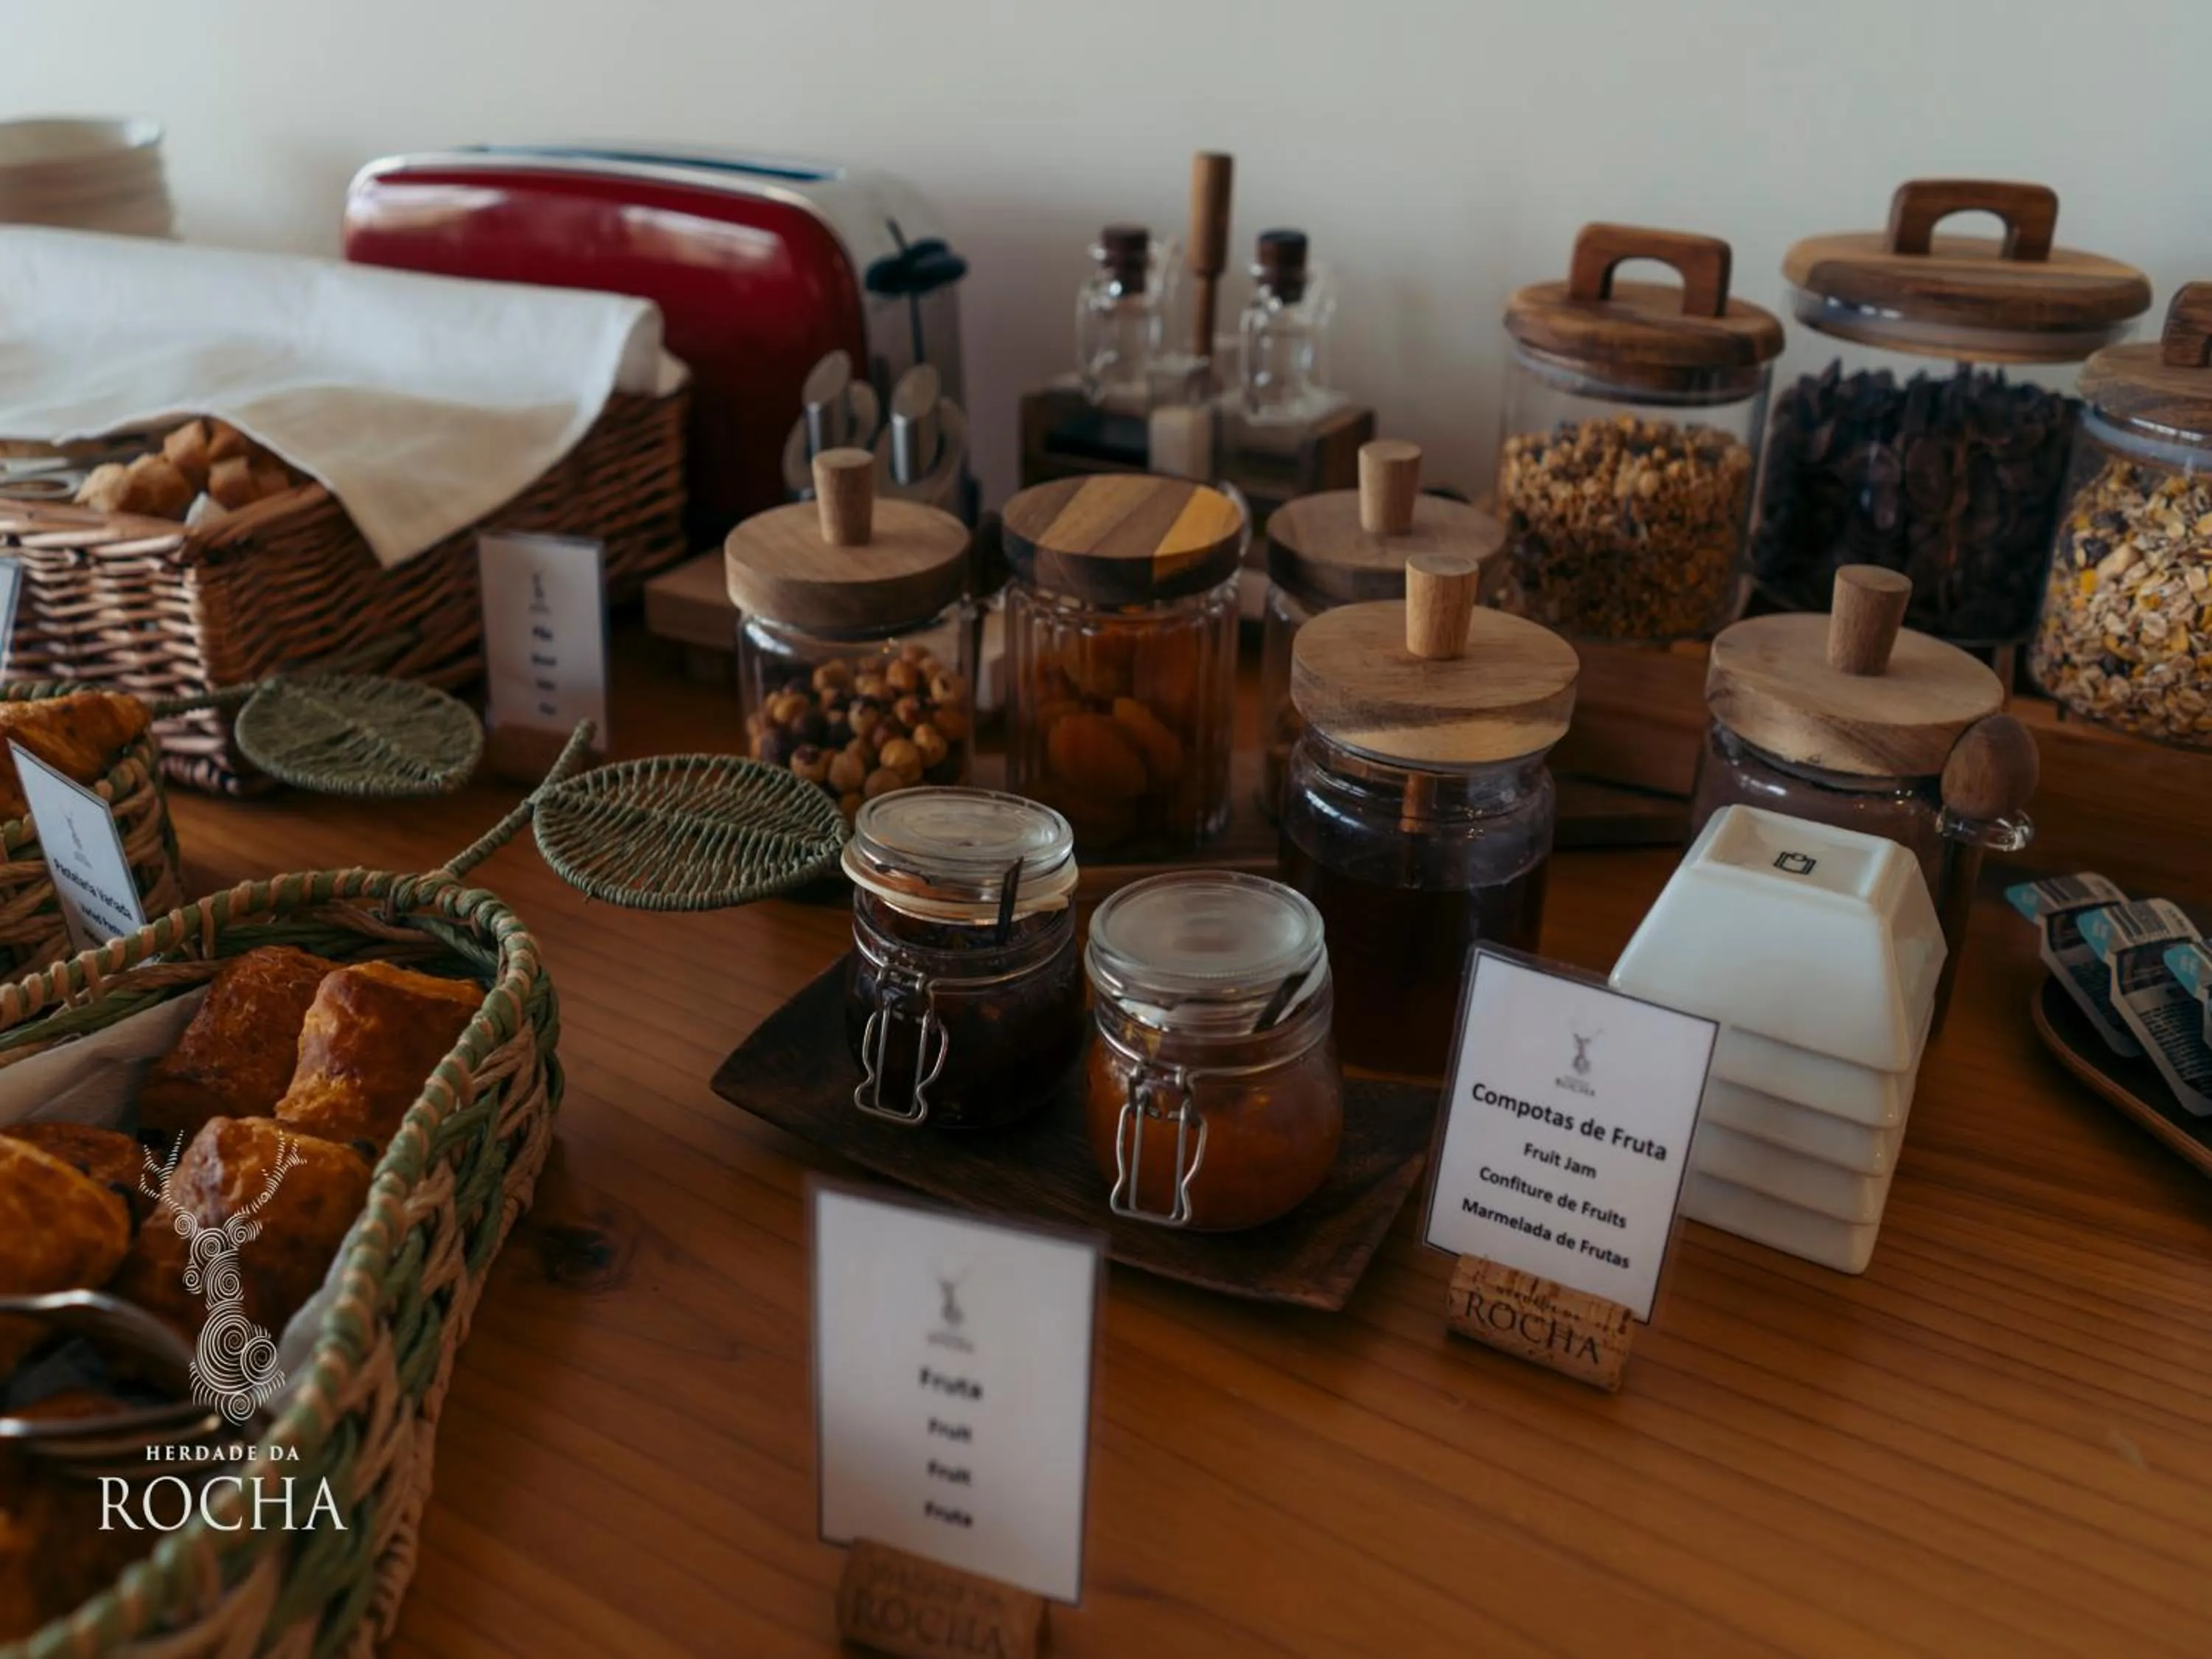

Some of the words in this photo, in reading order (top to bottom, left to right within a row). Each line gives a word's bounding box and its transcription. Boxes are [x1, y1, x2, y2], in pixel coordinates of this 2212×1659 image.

[1472, 1082, 1574, 1130] Compotas
[1580, 1110, 1606, 1141] de
[1611, 1128, 1668, 1161] Fruta
[1523, 1142, 1560, 1169] Fruit
[1565, 1155, 1597, 1180] Jam
[1462, 1197, 1552, 1242] Marmelada
[1556, 1227, 1576, 1251] de
[1579, 1239, 1630, 1269] Frutas
[1479, 1166, 1554, 1205] Confiture
[1557, 1188, 1578, 1211] de
[1581, 1200, 1627, 1229] Fruits
[1463, 1290, 1601, 1365] ROCHA
